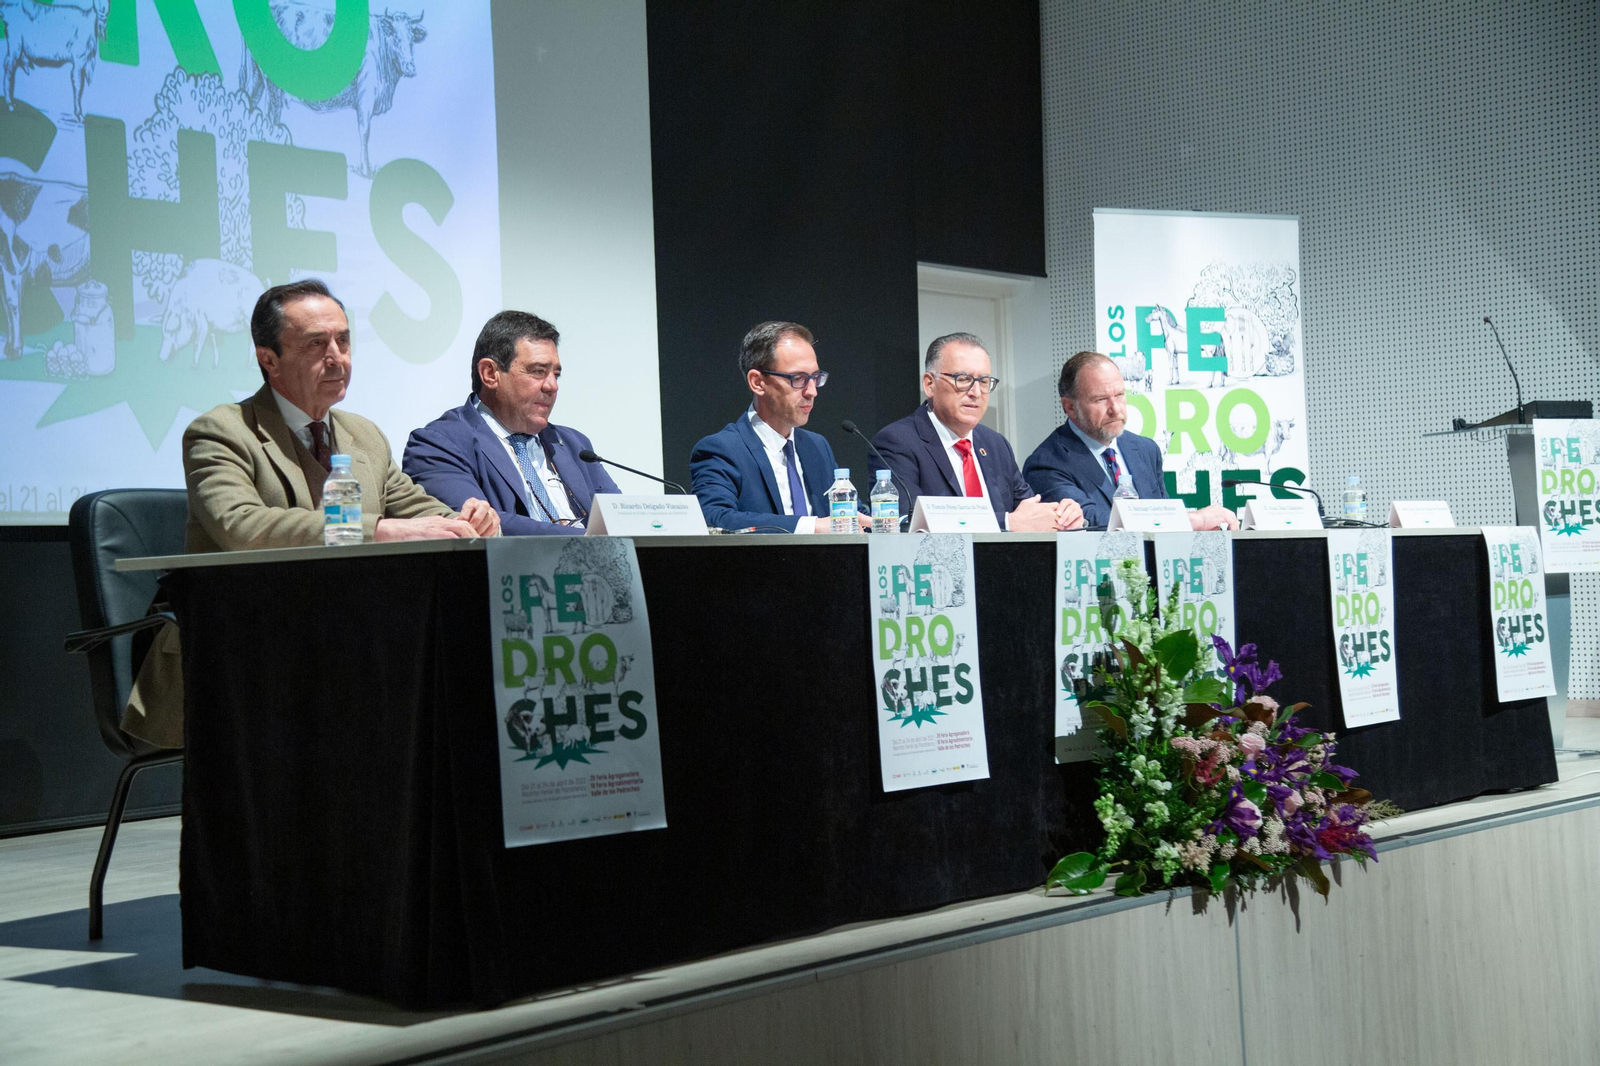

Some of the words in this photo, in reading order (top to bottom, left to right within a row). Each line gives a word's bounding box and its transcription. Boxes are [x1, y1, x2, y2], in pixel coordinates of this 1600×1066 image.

[1108, 304, 1126, 358] LOS
[1135, 305, 1228, 372] PE
[1550, 437, 1581, 463] PE
[20, 485, 38, 512] 21
[1541, 468, 1595, 495] DRO
[1064, 559, 1072, 590] LOS
[1173, 558, 1204, 593] PE
[1343, 553, 1368, 585] PE
[1498, 544, 1522, 572] PE
[502, 575, 514, 614] LOS
[878, 565, 888, 598] LOS
[891, 564, 933, 606] PE
[1076, 558, 1111, 597] PE
[1494, 578, 1533, 611] DRO
[519, 573, 586, 623] PE
[1336, 592, 1380, 627] DRO
[878, 614, 954, 660] DRO
[1061, 604, 1127, 645] DRO
[1183, 600, 1217, 637] RO
[1497, 613, 1545, 646] CHES
[501, 633, 618, 688] DRO
[1340, 630, 1391, 667] CHES
[881, 663, 974, 711] CHES
[505, 690, 647, 751] CHES
